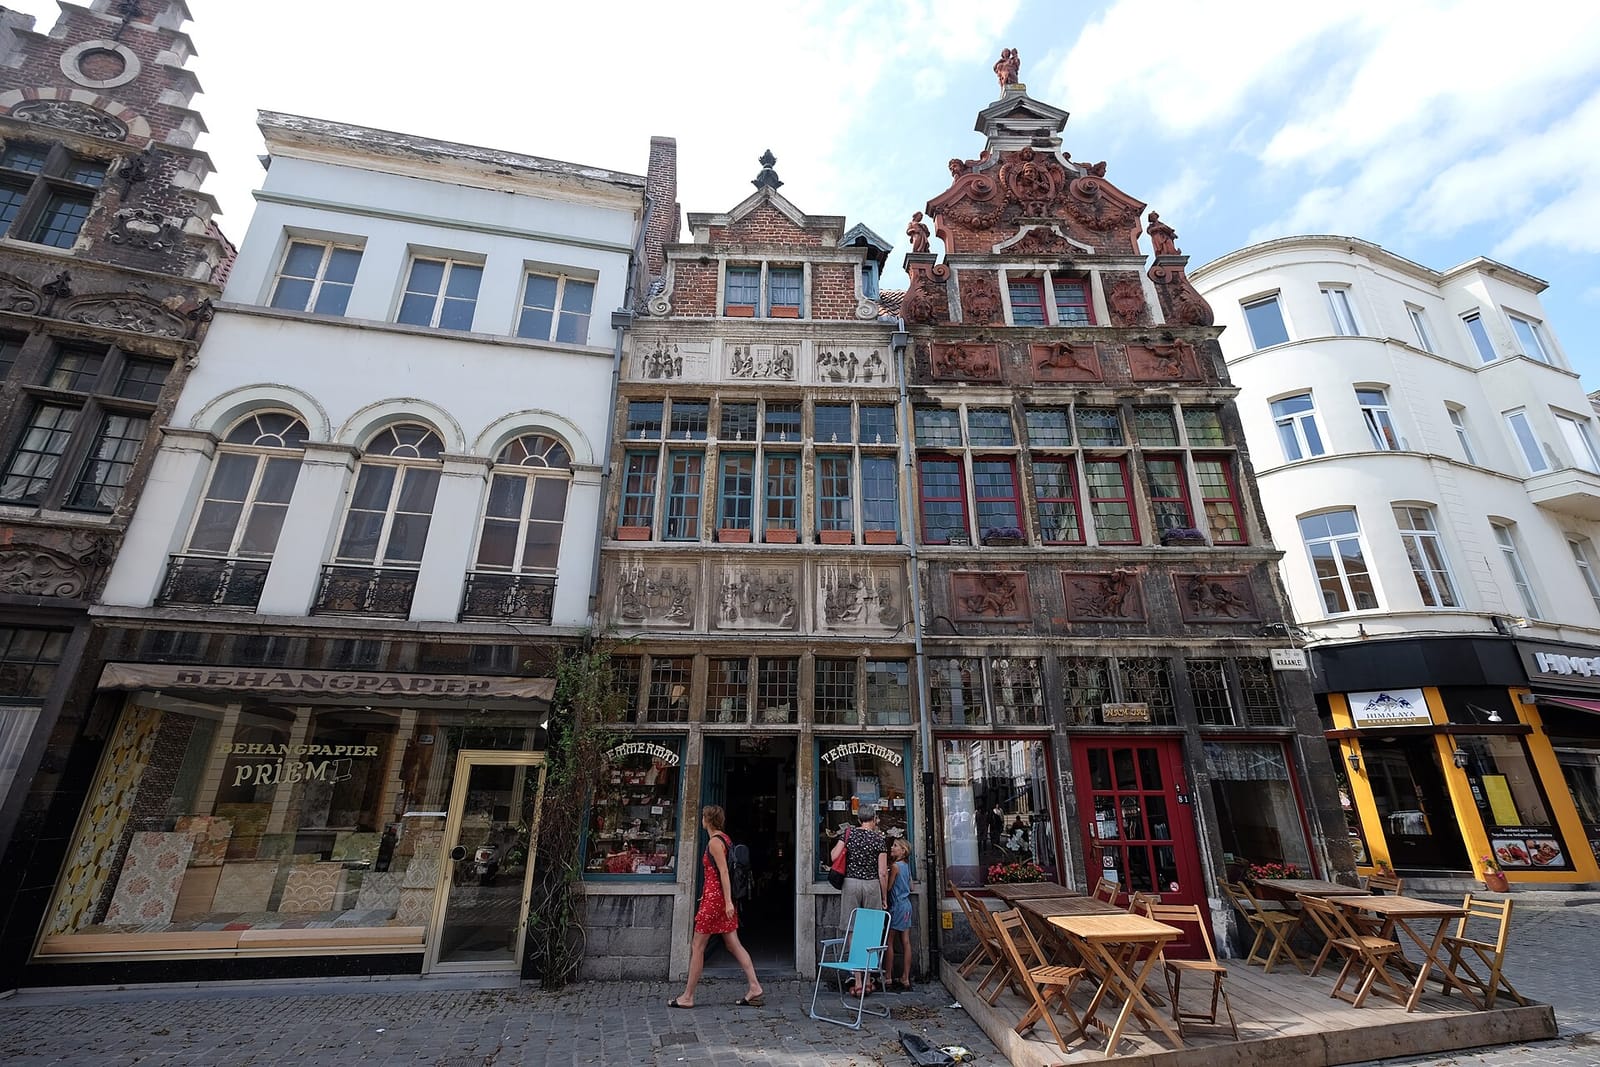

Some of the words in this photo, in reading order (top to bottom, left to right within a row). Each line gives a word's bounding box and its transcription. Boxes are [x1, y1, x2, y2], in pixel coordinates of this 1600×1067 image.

[175, 669, 490, 693] BEHANGPAPIER
[1366, 711, 1416, 719] HIMALAYA
[217, 743, 378, 757] BEHANGPAPIER
[604, 742, 680, 767] EMMERMAN
[821, 742, 903, 767] TEMMERMAN
